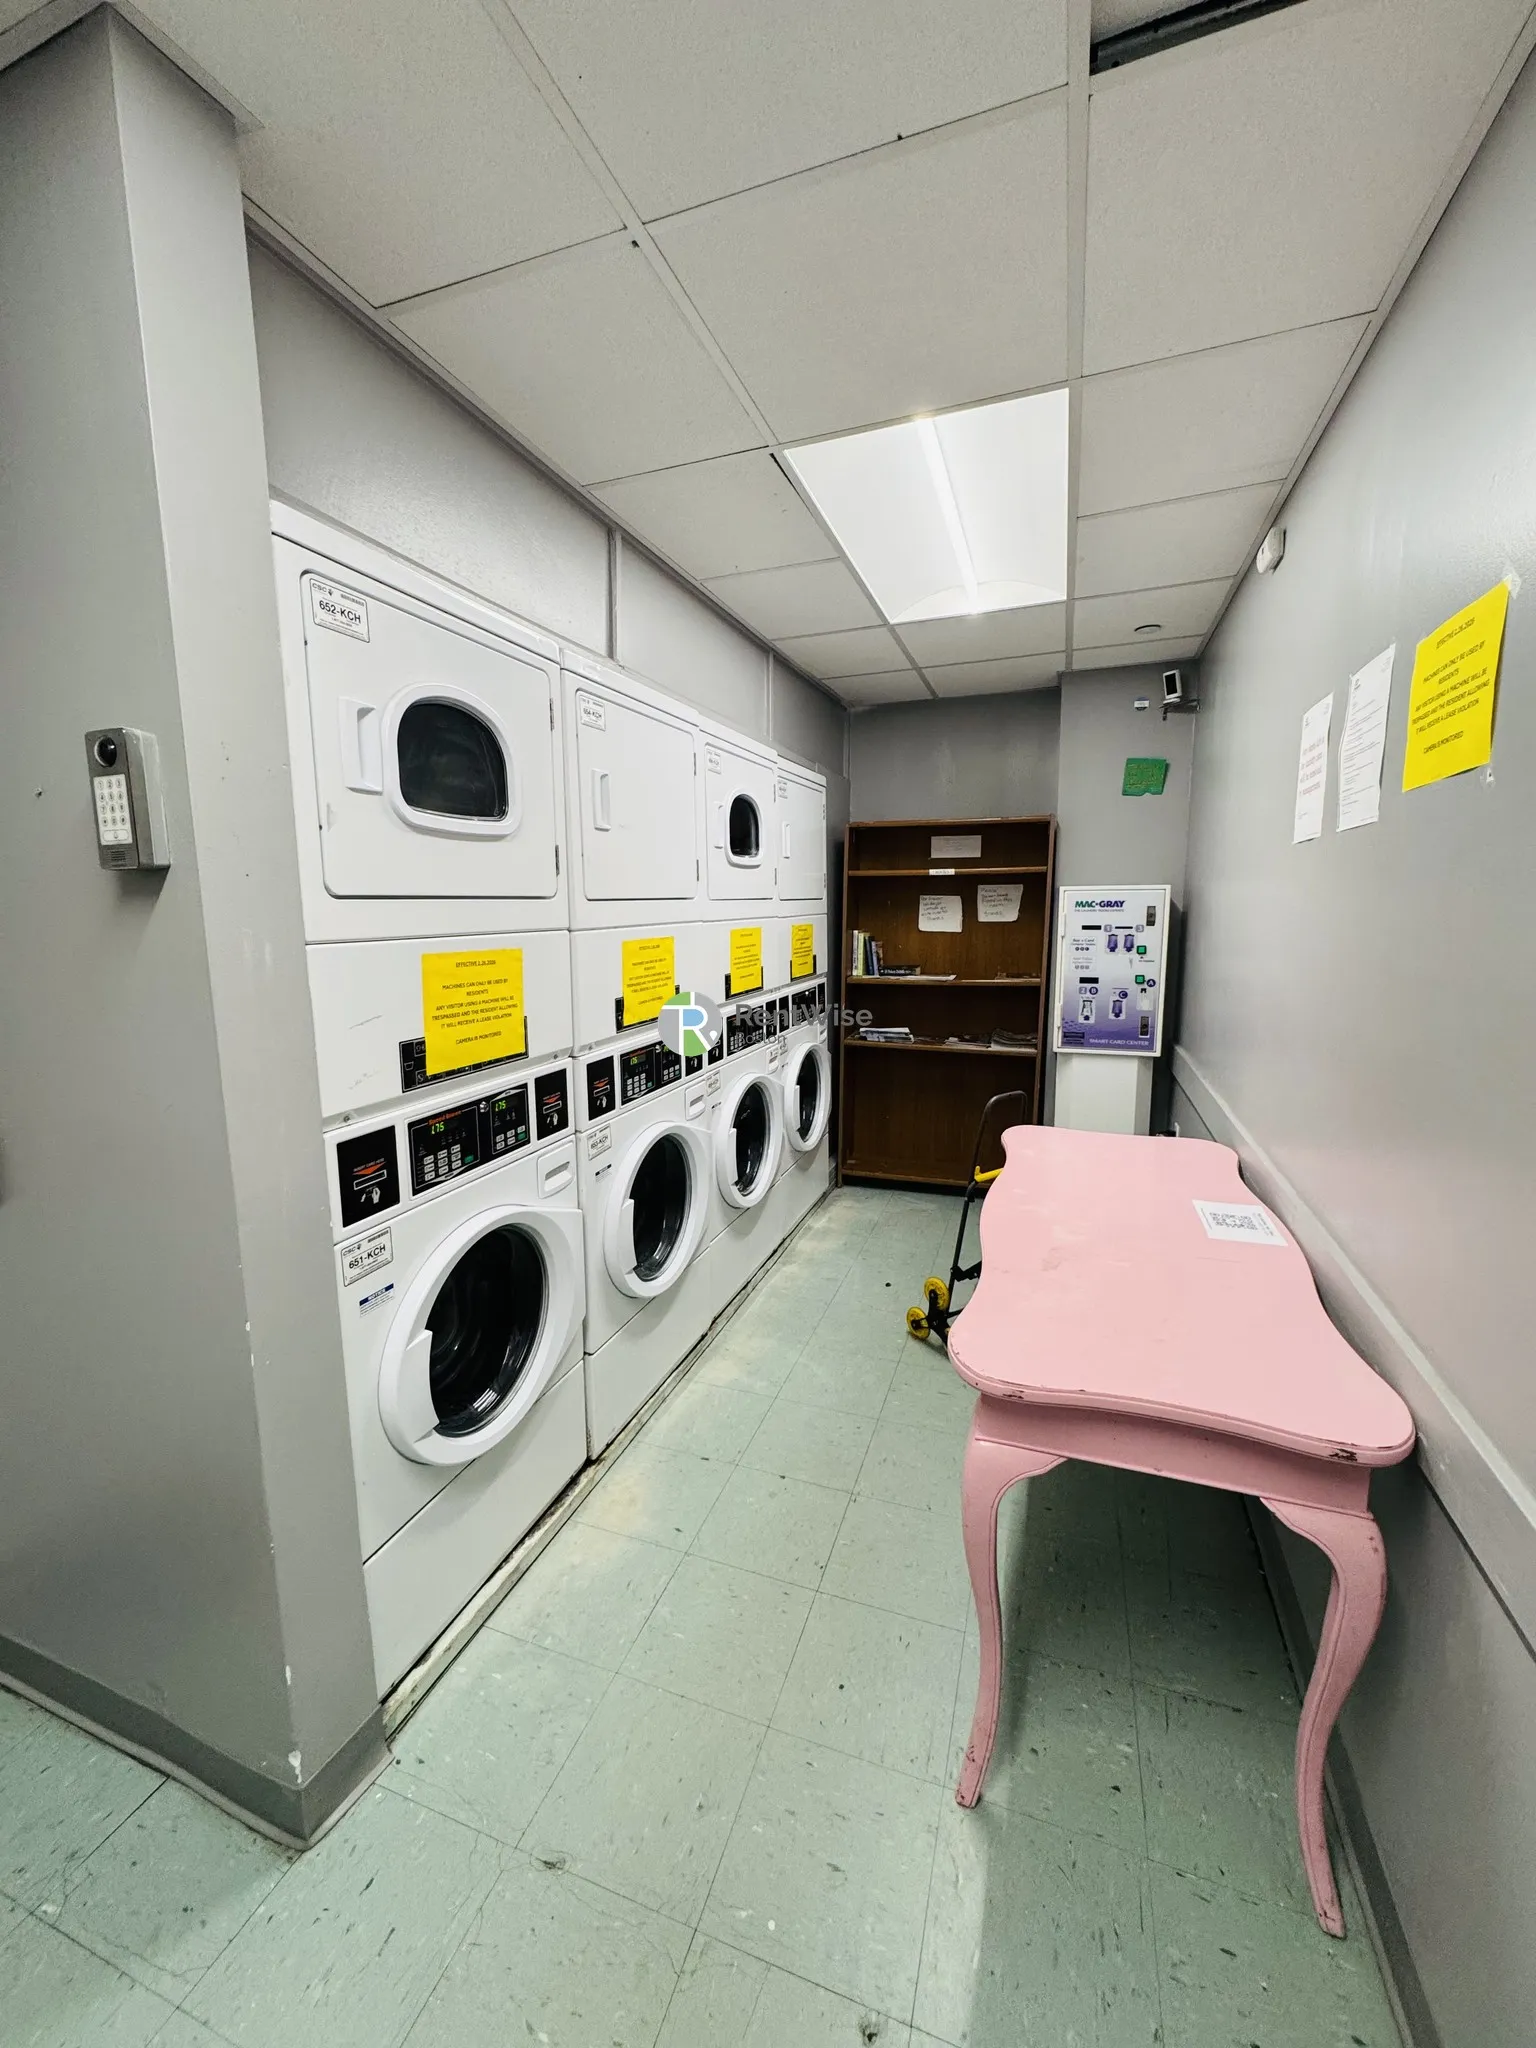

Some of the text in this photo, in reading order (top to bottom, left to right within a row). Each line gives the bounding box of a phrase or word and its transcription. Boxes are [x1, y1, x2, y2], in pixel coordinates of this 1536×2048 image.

[319, 600, 361, 624] 652-KCH
[442, 982, 465, 990] MACHINES
[432, 1012, 460, 1020] TRESPASSED
[457, 1018, 475, 1026] RECEIVE
[456, 1036, 473, 1045] CAMERA
[479, 1031, 502, 1039] MONITORED
[349, 1244, 386, 1269] 651-KCH
